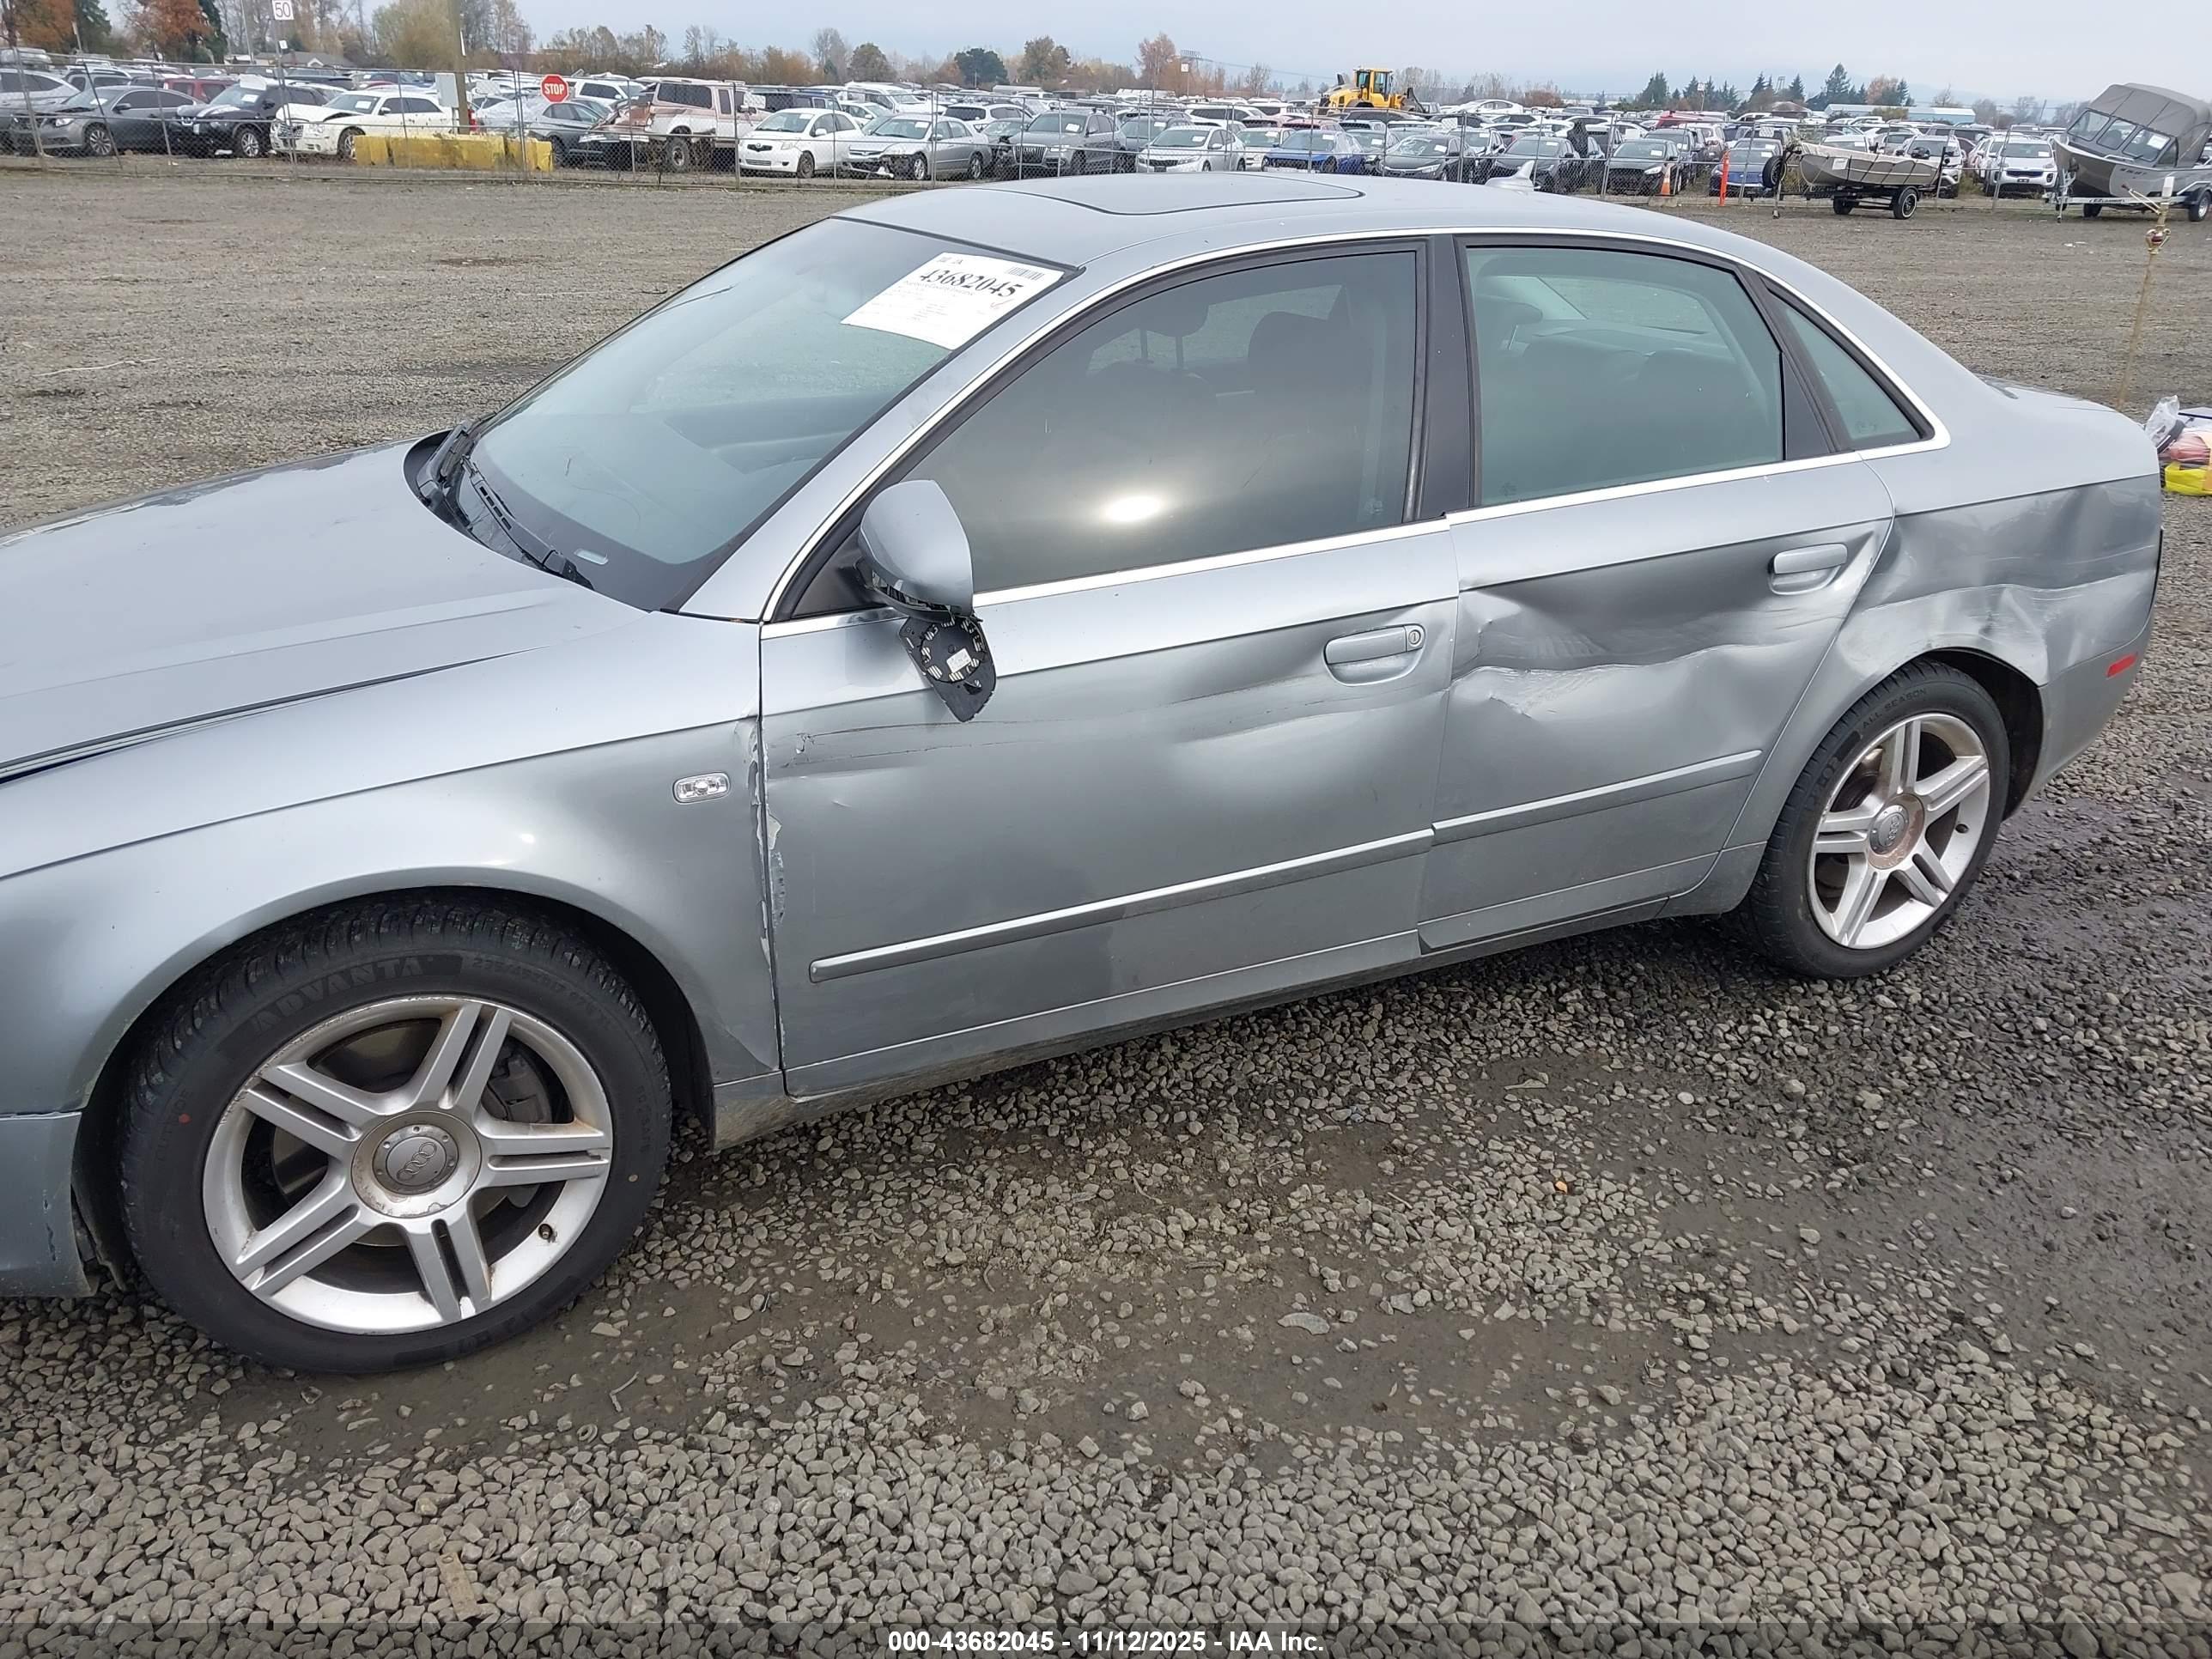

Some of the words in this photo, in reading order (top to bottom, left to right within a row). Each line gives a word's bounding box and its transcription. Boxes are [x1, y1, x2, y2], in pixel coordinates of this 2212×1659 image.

[275, 2, 290, 17] 50
[544, 82, 564, 95] STOP
[920, 269, 1024, 297] 43682045
[252, 957, 424, 1033] ADVANTA
